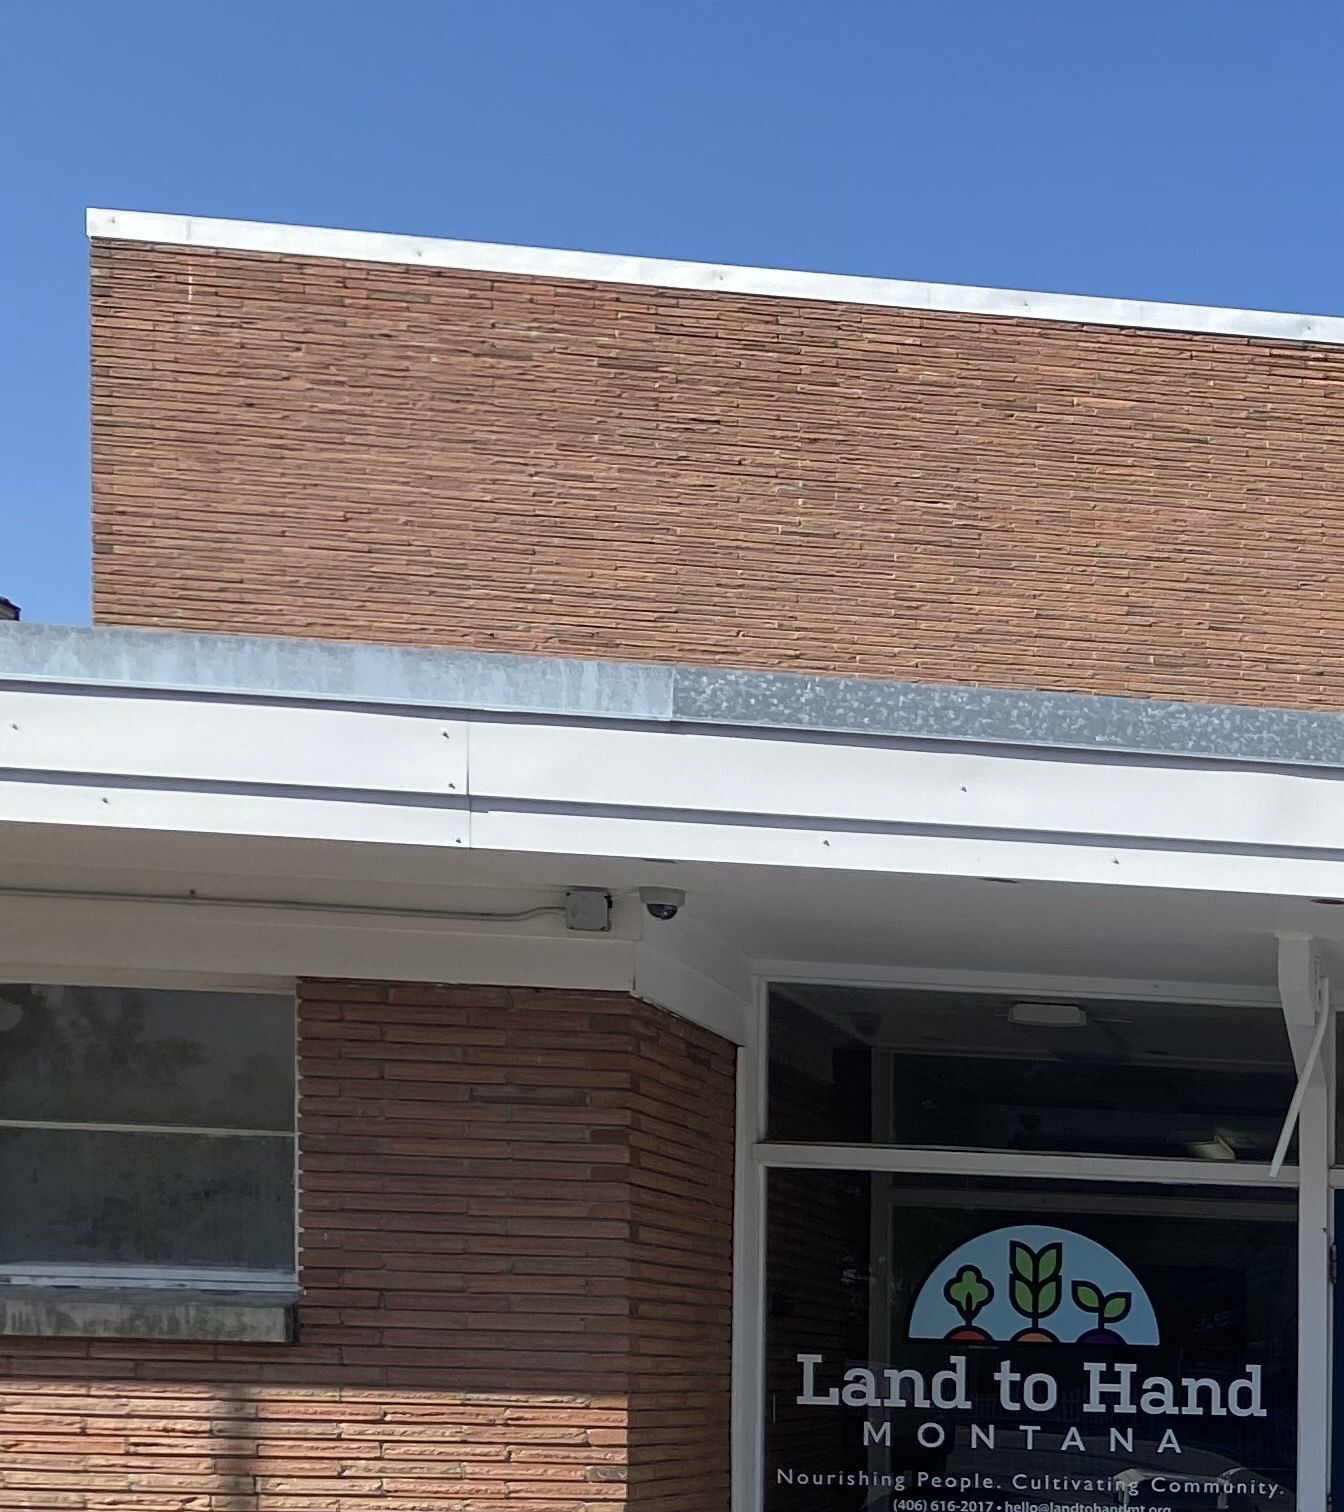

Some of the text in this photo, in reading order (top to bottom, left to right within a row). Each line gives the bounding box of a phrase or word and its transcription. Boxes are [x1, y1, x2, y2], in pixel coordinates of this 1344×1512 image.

[795, 1354, 1267, 1417] Land to Hand
[864, 1421, 1182, 1454] MONTANA
[777, 1468, 1285, 1499] Nourishing People. Cultivating Community.
